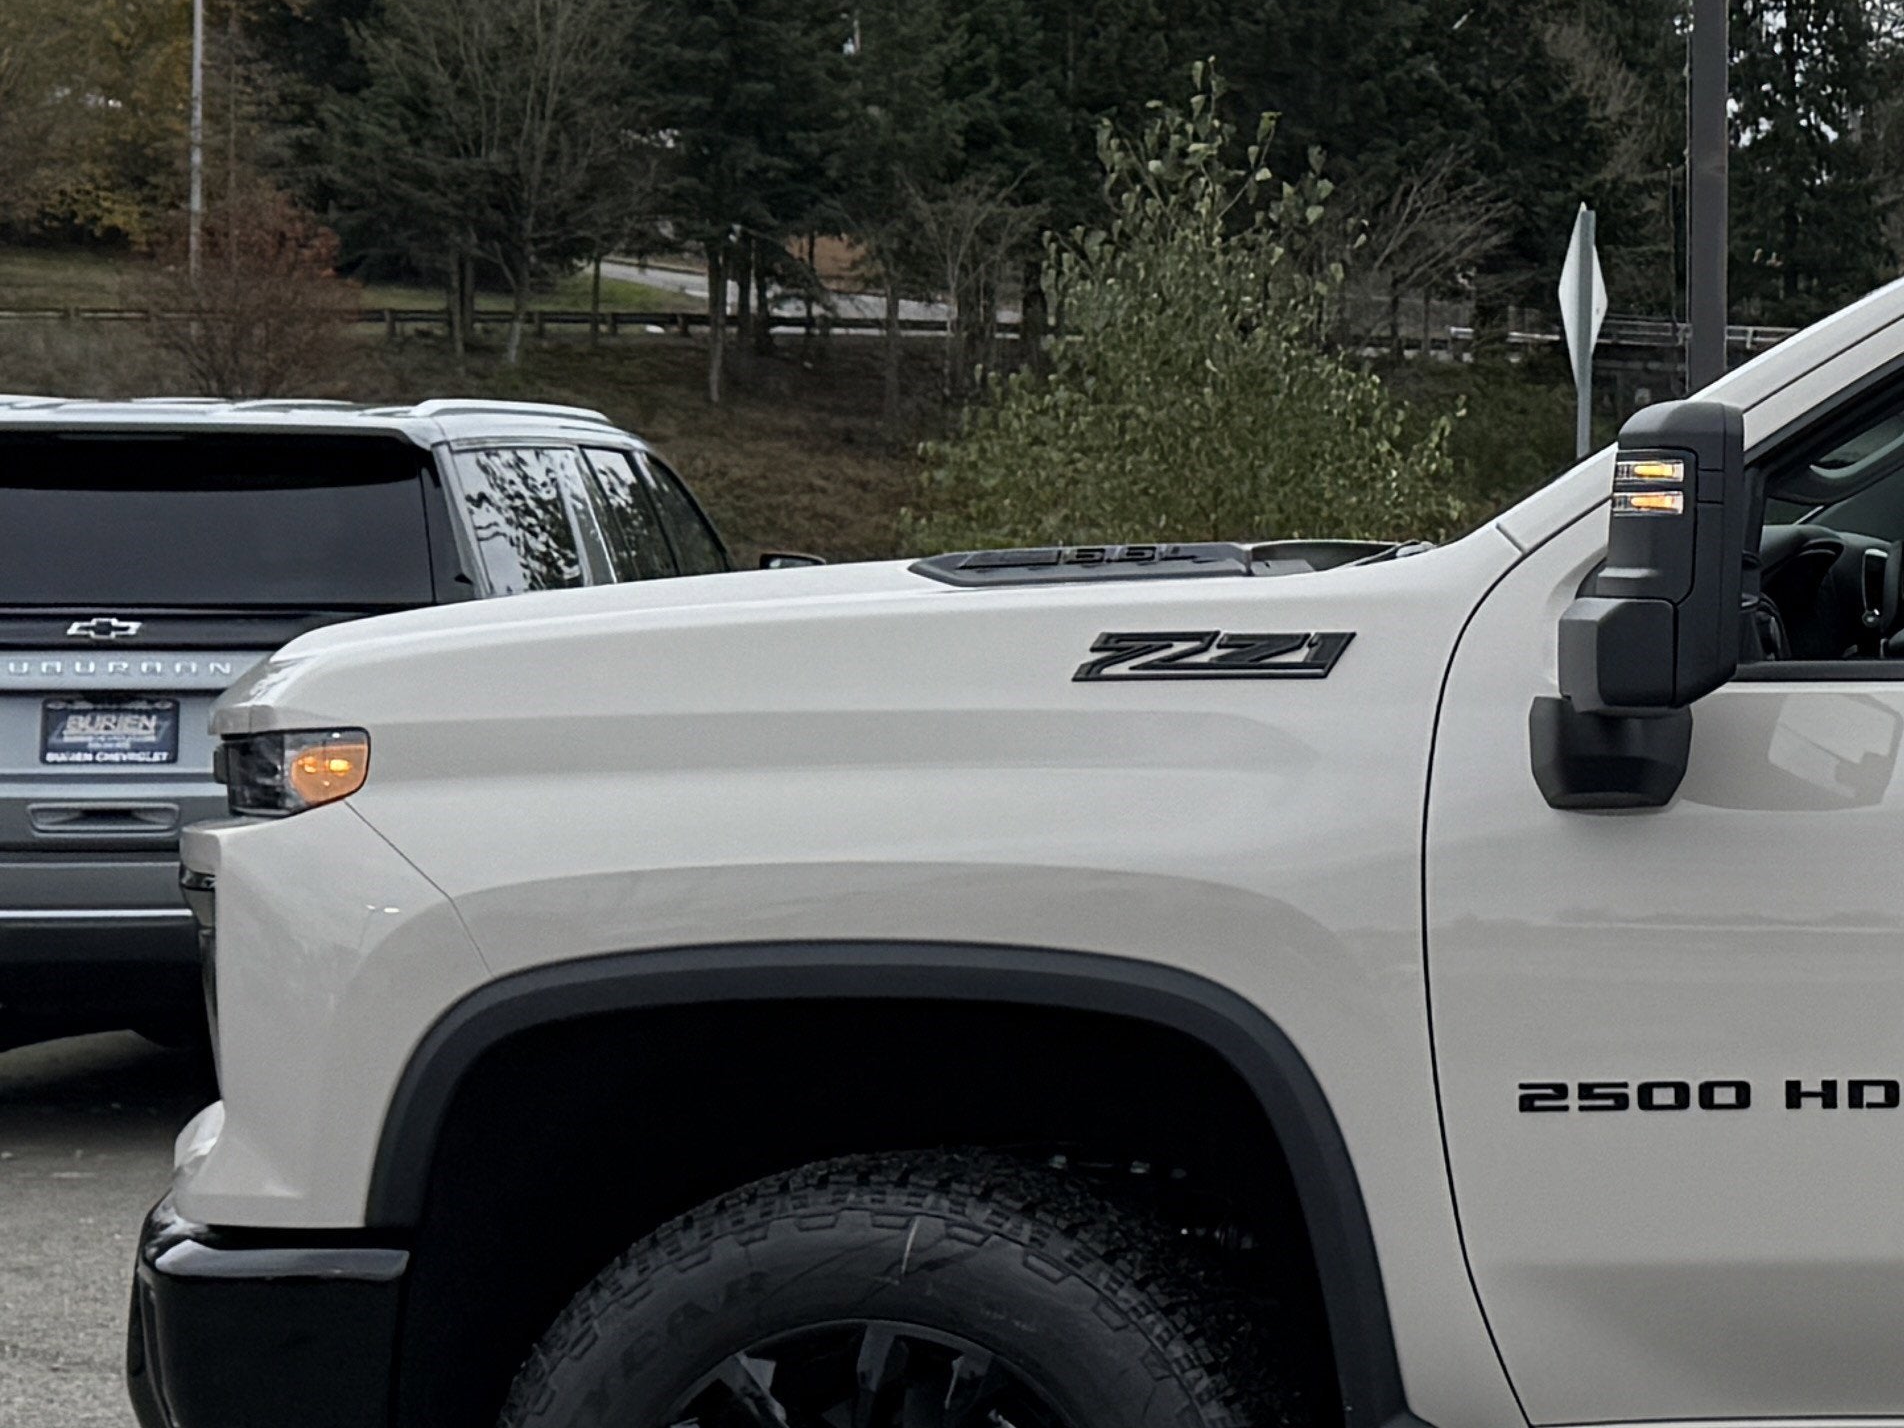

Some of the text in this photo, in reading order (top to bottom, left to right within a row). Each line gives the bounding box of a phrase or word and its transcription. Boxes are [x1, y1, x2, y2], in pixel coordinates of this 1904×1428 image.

[1072, 631, 1357, 682] Z71
[8, 661, 232, 674] UBURBAN
[66, 714, 157, 732] BURIEN
[95, 751, 169, 762] CHEVROLET
[1518, 1079, 1900, 1113] 2500 HD
